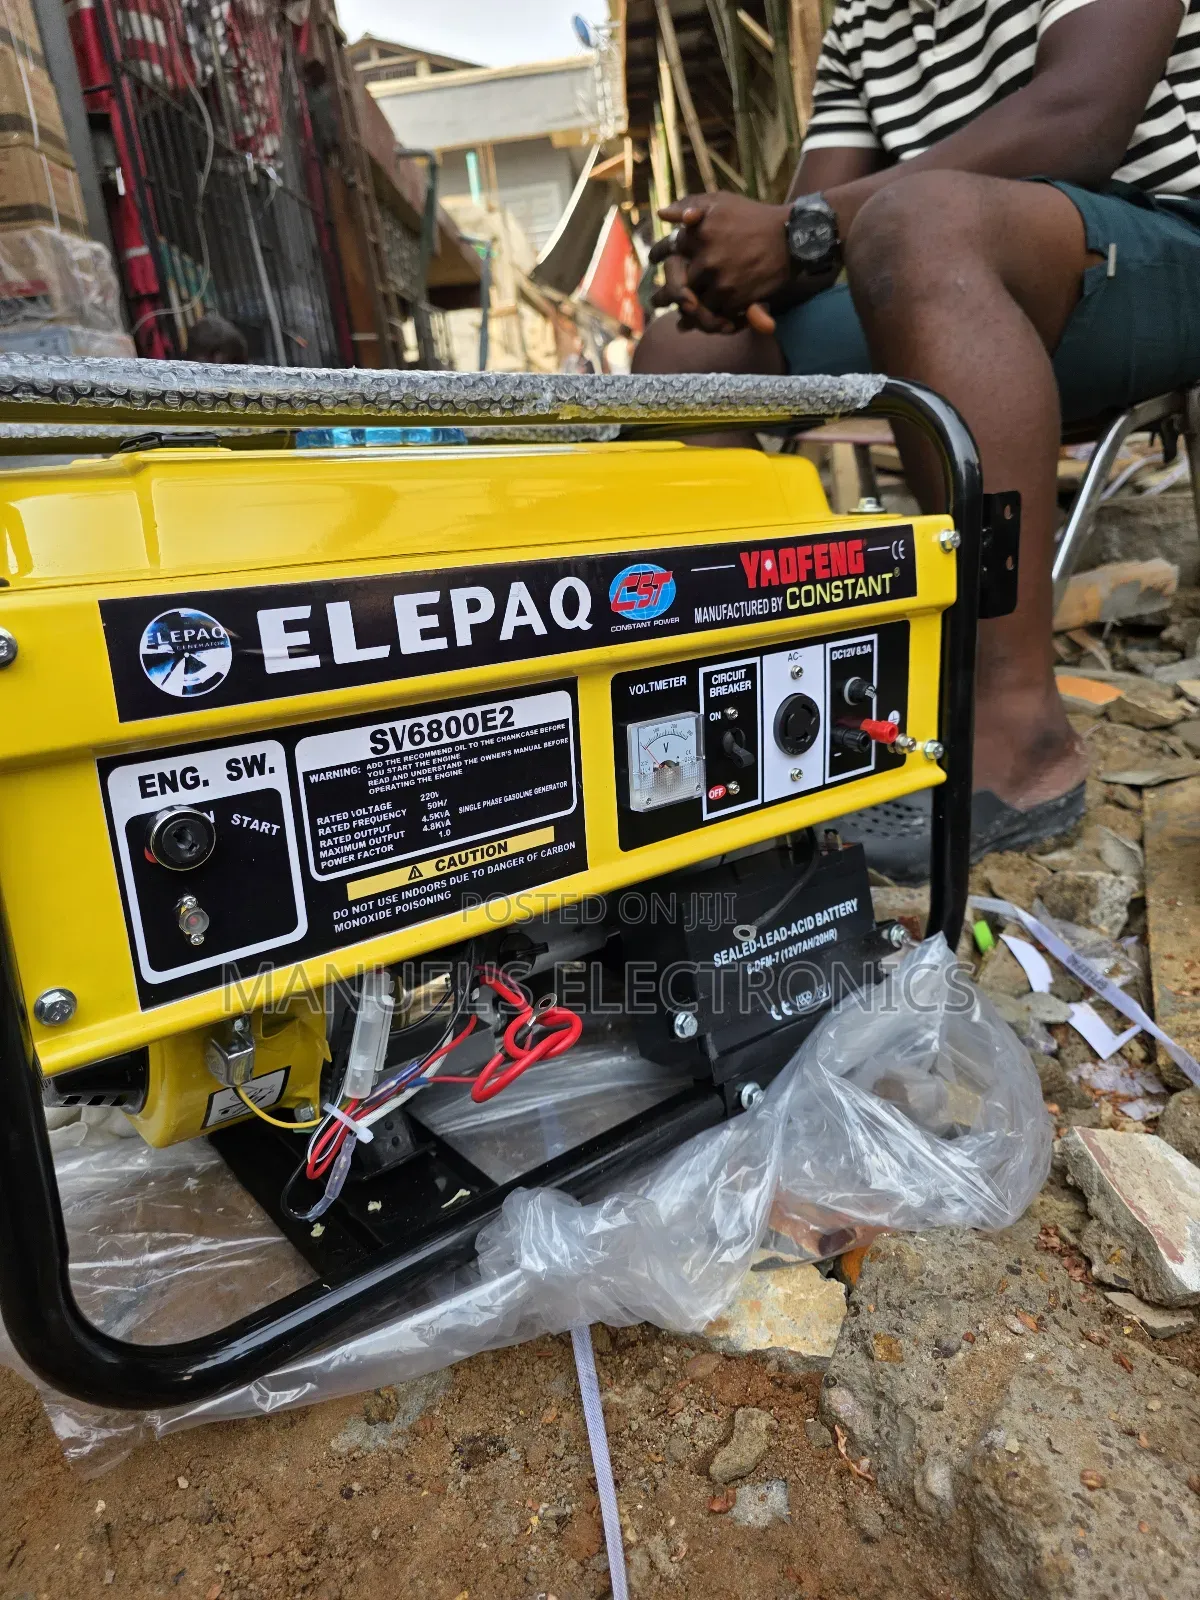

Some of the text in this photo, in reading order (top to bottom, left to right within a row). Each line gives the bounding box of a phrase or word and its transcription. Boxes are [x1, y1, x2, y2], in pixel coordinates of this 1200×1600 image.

[740, 539, 865, 589] YAOFENG
[611, 570, 673, 613] CST
[611, 617, 680, 633] CONSTANT POWER
[694, 598, 769, 624] MANUFACTURED
[771, 596, 783, 613] BY
[146, 626, 226, 646] ELEPAQ
[257, 576, 593, 675] ELEPAQ
[832, 644, 872, 660] DC12V 8.3A
[629, 675, 687, 696] VOLTMETER
[709, 680, 752, 698] BREAKER
[711, 668, 746, 685] CIRCUIT
[369, 705, 515, 755] SV6800E2
[709, 711, 722, 721] ON
[366, 723, 566, 770] ADD THE RECOMMEND OIL TO THE CHANKCASE BEFORE
[663, 742, 669, 753] V
[137, 752, 276, 800] ENG. SW.
[309, 765, 361, 784] WARNING:
[367, 753, 461, 778] YOU START THE ENGINE
[368, 737, 569, 787] READ AND UNDERSTAND THE OWNER'S MANUAL BEFORE
[368, 768, 463, 795] OPERATING THE ENGINE
[708, 788, 723, 800] OFF
[458, 781, 568, 814] SINGLE PHASE GASOLINE GENERATOR
[231, 813, 281, 836] START
[316, 811, 349, 826] RATED
[350, 801, 393, 817] VOLTAGE
[318, 822, 350, 837] RATED
[352, 808, 407, 828] FREQUENCY
[319, 809, 451, 848] RATED OUTPUT 4.5KVA
[319, 818, 452, 858] MAXIMUM OUTPUT 4.8KVA
[321, 828, 452, 870] POWER FACTOR 1.0
[435, 840, 508, 872] CAUTION
[333, 841, 576, 921] DO NOT USE INDOORS DUE TO DANGER OF CARBON
[334, 890, 452, 934] MONOXIDE POISONING
[713, 897, 859, 967] SEALED-LEAD-ACID BATTERY
[780, 928, 838, 963] (12V7AH/20HR)
